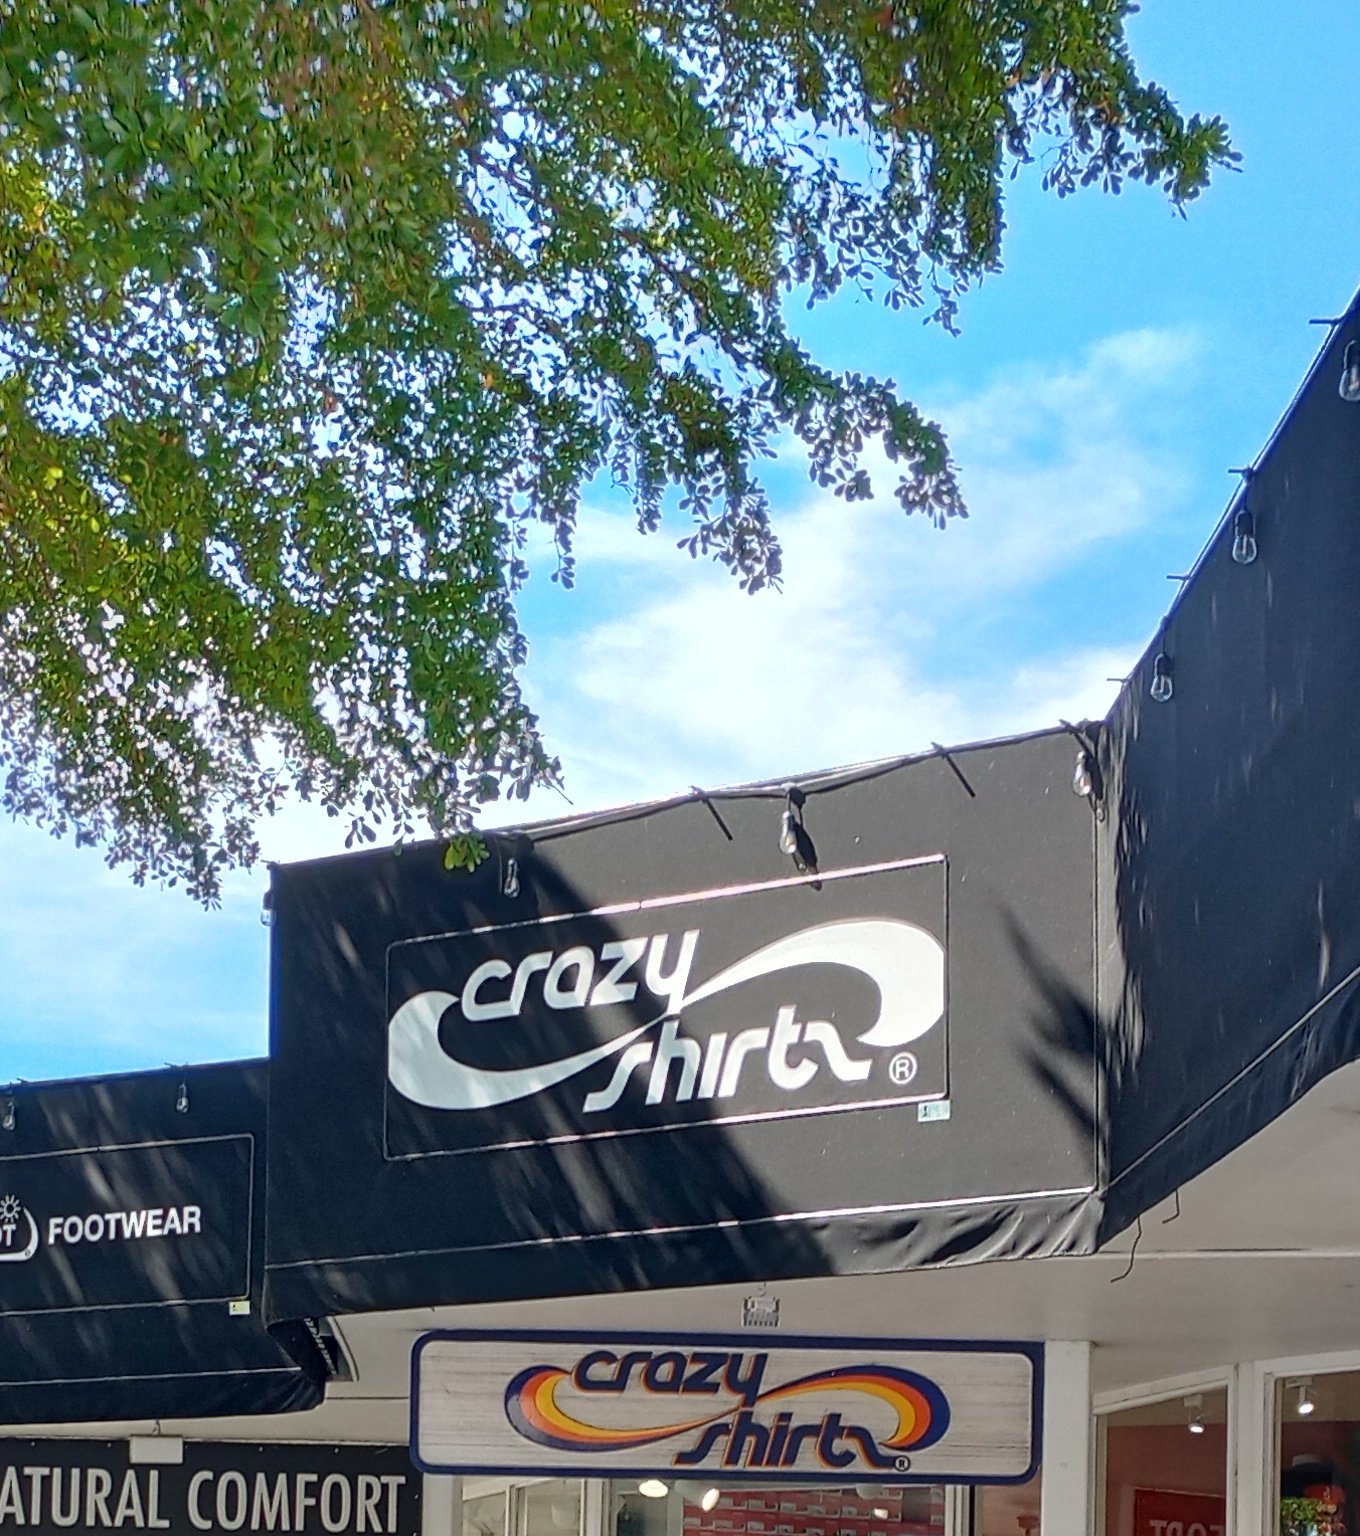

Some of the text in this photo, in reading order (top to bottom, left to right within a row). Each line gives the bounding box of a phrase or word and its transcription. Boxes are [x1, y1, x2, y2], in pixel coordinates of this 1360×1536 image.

[461, 929, 700, 1021] crazy
[583, 1005, 871, 1113] shirts
[48, 1205, 202, 1245] FOOTWEAR
[571, 1350, 768, 1406] crazy
[672, 1411, 897, 1468] shirts
[187, 1471, 406, 1533] COMFORT
